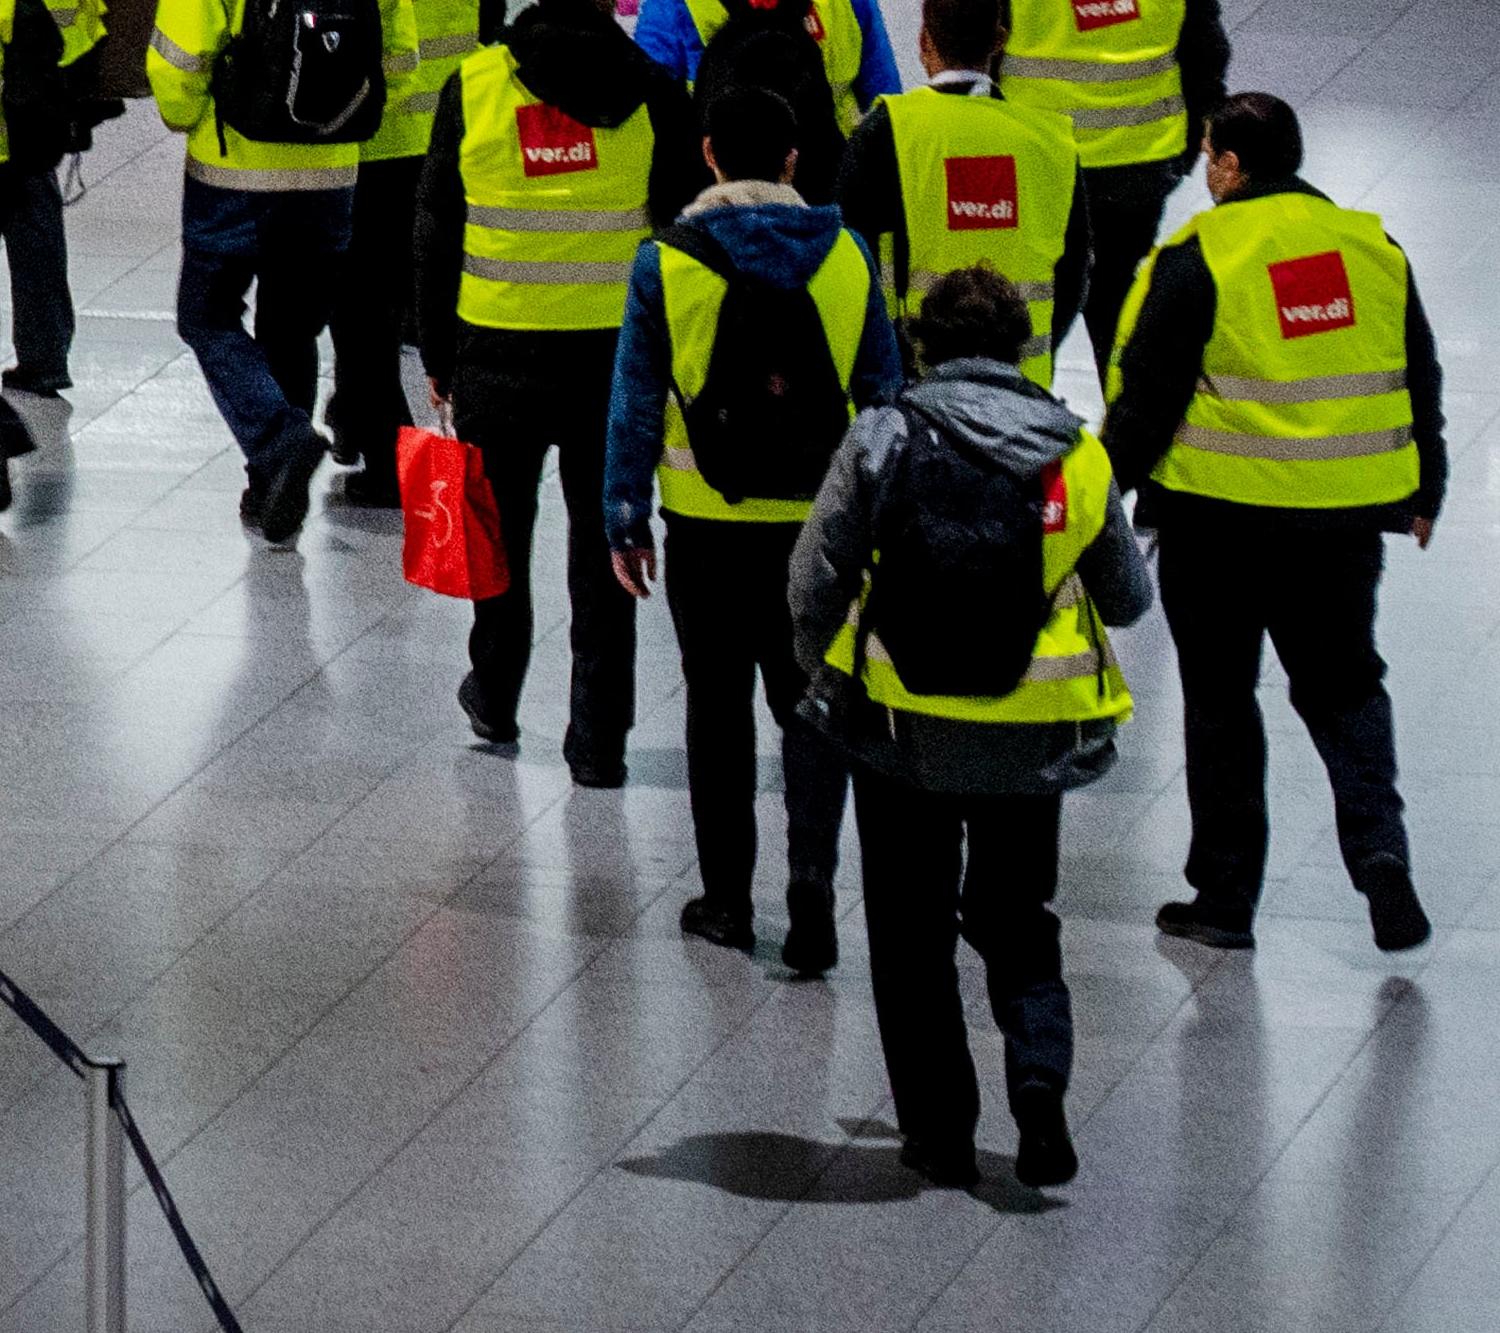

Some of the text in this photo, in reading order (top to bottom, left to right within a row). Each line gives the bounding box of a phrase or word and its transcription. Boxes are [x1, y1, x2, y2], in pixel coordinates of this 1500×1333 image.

[524, 140, 593, 165] ver.di
[949, 199, 1014, 221] ver.di
[1277, 297, 1351, 324] ver.di
